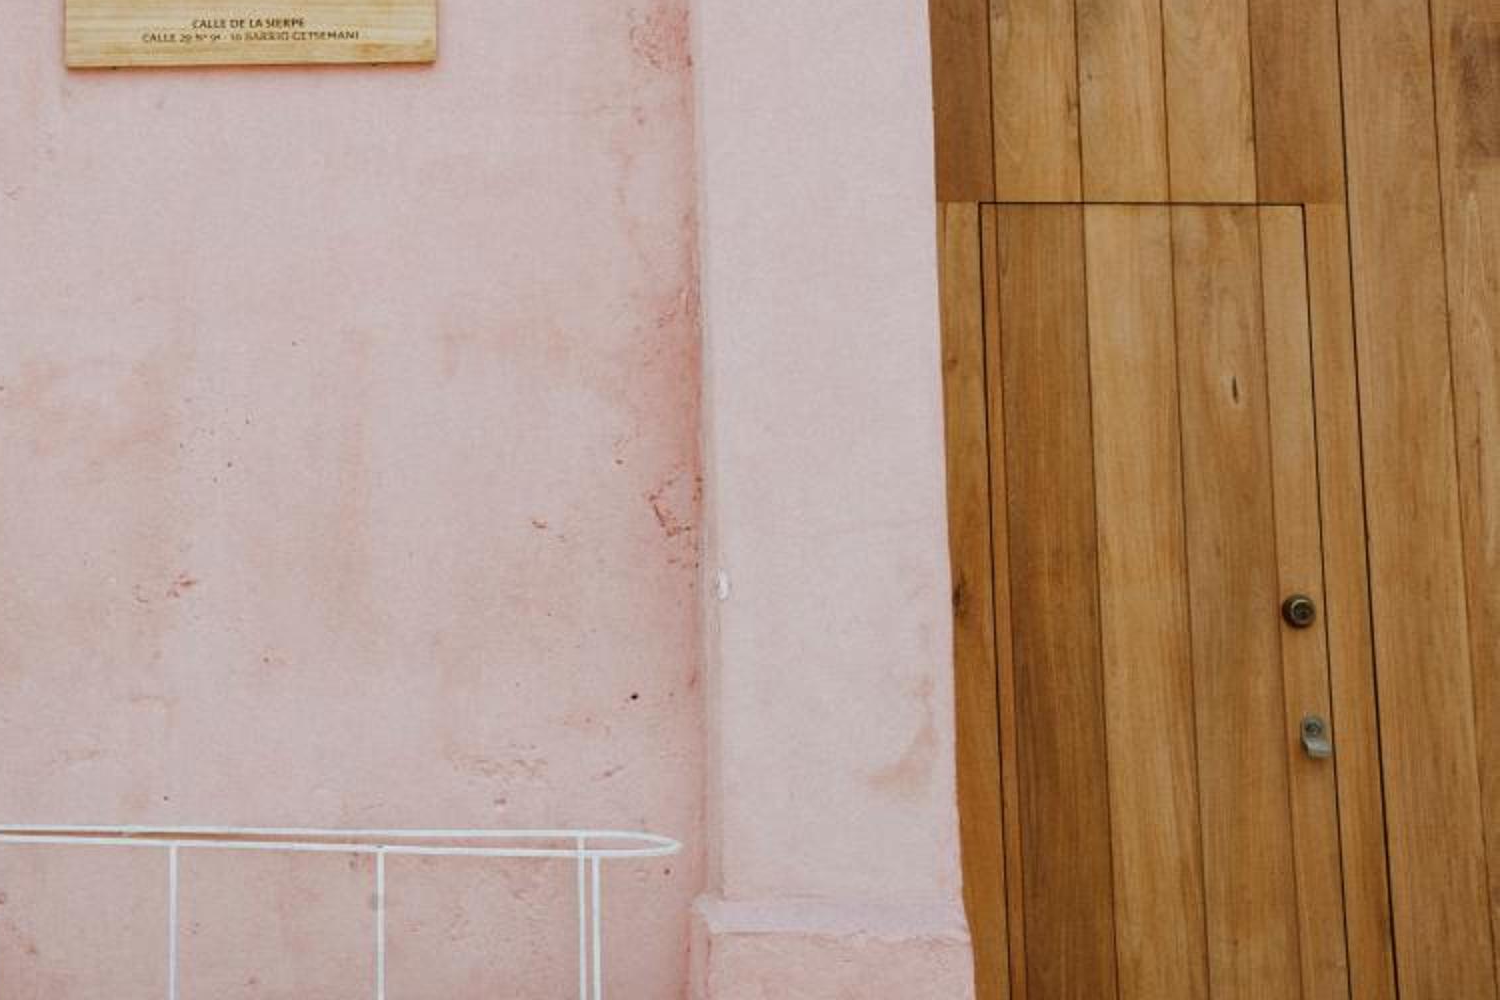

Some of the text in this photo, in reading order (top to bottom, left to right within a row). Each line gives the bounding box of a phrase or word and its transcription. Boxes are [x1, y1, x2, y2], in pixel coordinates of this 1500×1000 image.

[192, 17, 305, 29] CALLE DE LA SIERPE
[141, 33, 177, 43] CALLE
